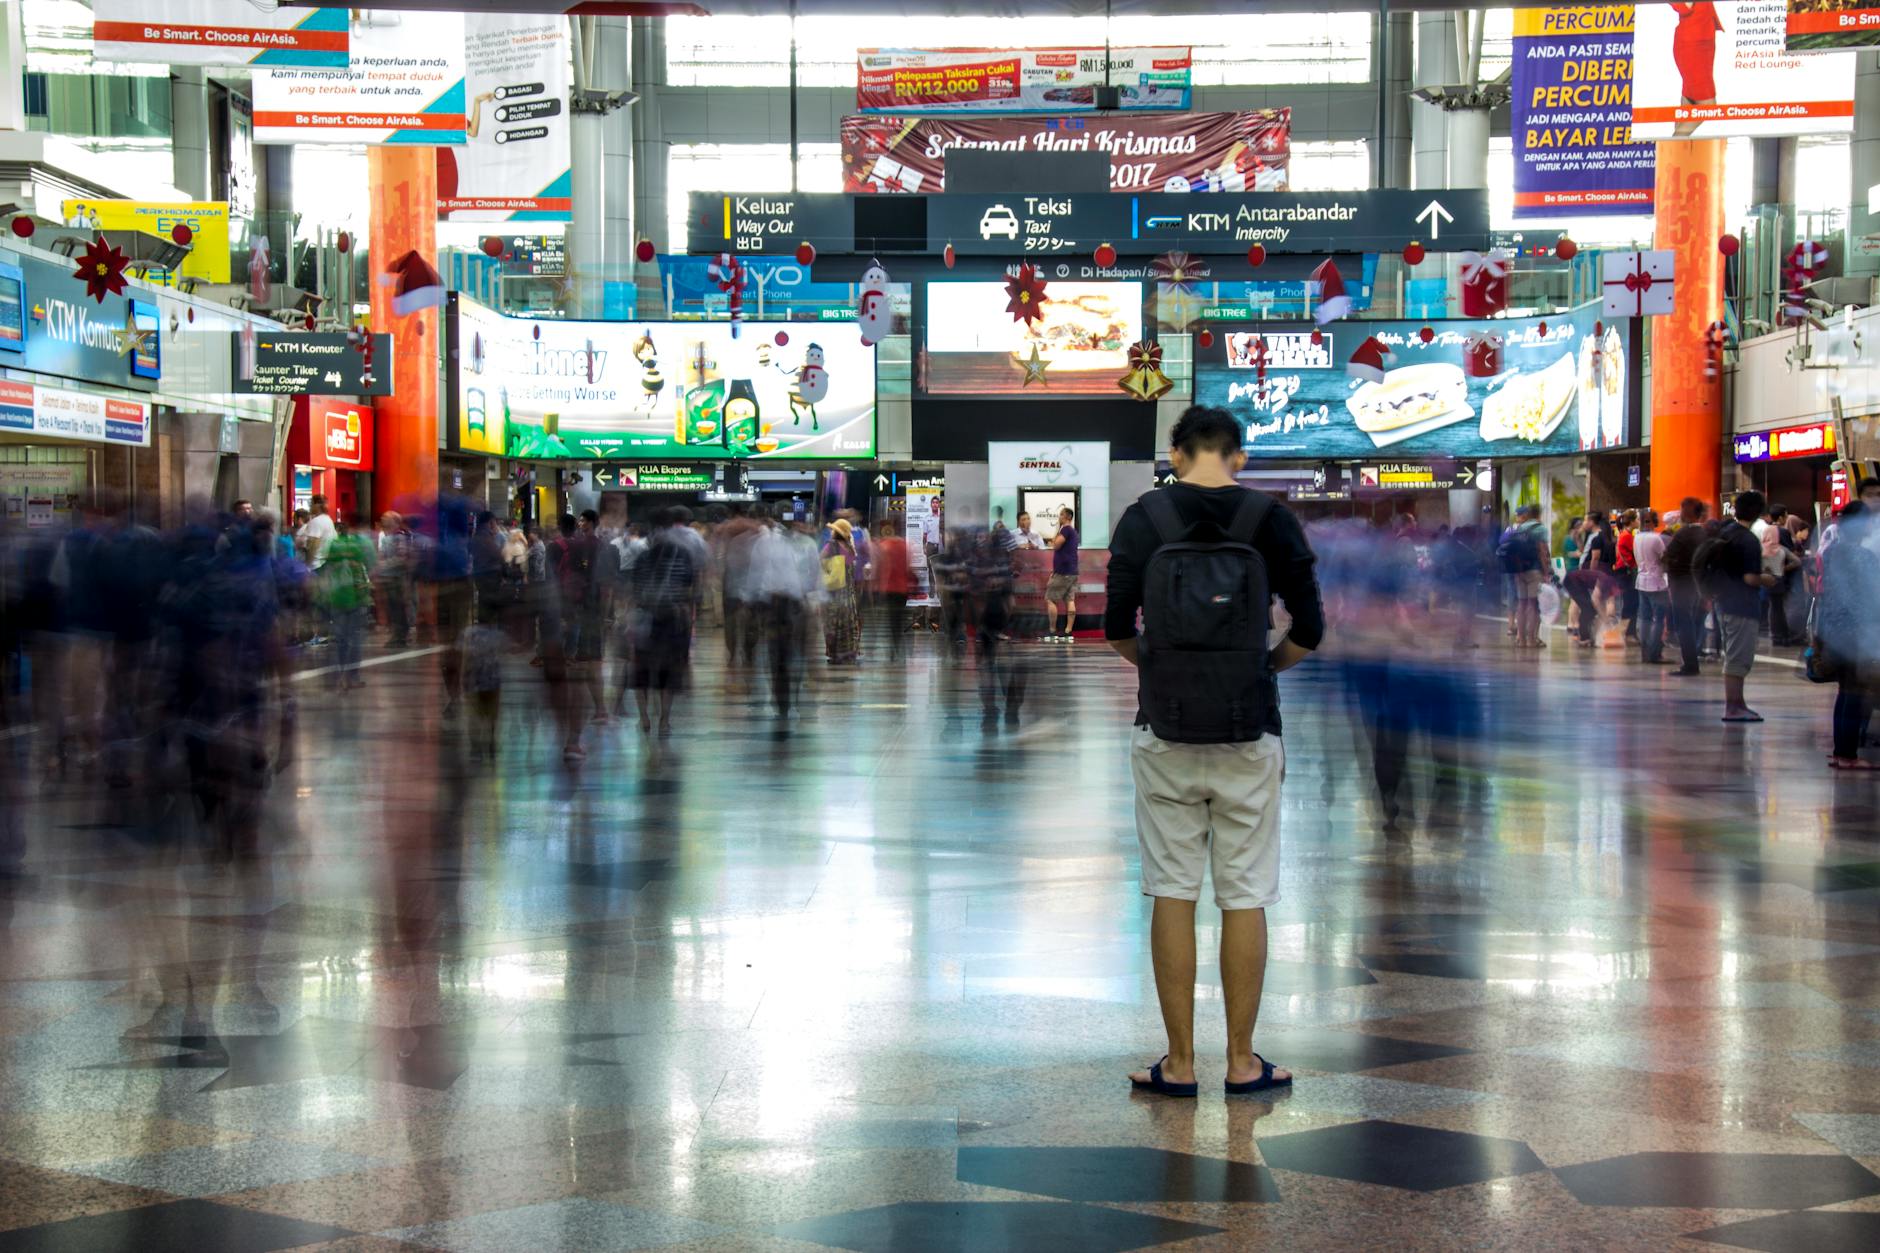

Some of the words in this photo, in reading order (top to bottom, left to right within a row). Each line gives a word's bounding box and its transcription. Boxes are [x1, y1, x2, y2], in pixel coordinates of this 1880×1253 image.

[1737, 5, 1756, 14] dan
[1736, 16, 1770, 25] faedah
[1839, 16, 1856, 26] Be
[144, 27, 161, 39] Be
[163, 28, 202, 42] Smart.
[205, 30, 250, 44] Choose
[252, 33, 299, 46] AirAsia.
[1736, 27, 1780, 37] menarik,
[1736, 38, 1780, 48] percuma
[1527, 46, 1566, 59] ANDA
[1568, 44, 1602, 57] PASTI
[1735, 50, 1774, 59] AirAsia
[363, 56, 418, 69] keperluan
[1735, 61, 1756, 70] Red
[1760, 60, 1804, 70] Lounge.
[271, 69, 298, 79] kami
[300, 70, 365, 82] mempunyai
[368, 72, 406, 82] tempat
[410, 72, 444, 81] duduk
[944, 68, 986, 79] Taksiran
[986, 64, 1015, 75] Cukai
[862, 74, 893, 84] Nikmati
[288, 86, 316, 95] yang
[319, 85, 357, 94] terbaik
[360, 86, 391, 96] untuk
[394, 86, 423, 96] anda.
[508, 86, 532, 95] BAGASI
[895, 78, 978, 97] RM12,000
[1532, 84, 1632, 108] PERCUM
[508, 104, 526, 114] PILIH
[526, 102, 552, 111] TEMPAT
[1675, 109, 1689, 119] Be
[1691, 108, 1724, 118] Smart.
[1727, 107, 1766, 117] Choose
[1768, 106, 1808, 116] AirAsia.
[296, 115, 309, 124] Be
[311, 116, 344, 124] Smart.
[346, 116, 384, 125] Choose
[386, 117, 424, 126] AirAsia.
[509, 112, 533, 120] DUDUK
[1526, 113, 1550, 125] JADI
[1551, 112, 1604, 124] MENGAPA
[1607, 112, 1632, 122] AND
[510, 129, 544, 139] HIDANGAN
[1525, 128, 1596, 148] BAYAR
[1033, 132, 1091, 152] Hari
[1094, 130, 1197, 156] Krismas
[1524, 152, 1560, 162] DENGAN
[1586, 151, 1610, 160] ANDA
[1612, 150, 1641, 159] HANYA
[1536, 162, 1561, 172] UNTUK
[1562, 162, 1580, 171] APA
[1581, 161, 1606, 170] YANG
[1607, 160, 1632, 170] ANDA
[1557, 194, 1584, 202] Smart.
[1585, 193, 1616, 202] Choose
[1618, 192, 1648, 200] AirAsia.
[448, 200, 474, 208] Smart.
[476, 200, 506, 208] Choose
[508, 200, 538, 208] AirAsia.
[736, 198, 794, 216] Keluar
[1024, 198, 1072, 216] Teksi
[135, 208, 222, 216] PERKHIDMATAN
[1188, 213, 1230, 232] KTM
[1236, 204, 1358, 222] Antarabandar
[736, 220, 765, 236] Way
[768, 219, 794, 234] Out
[1024, 220, 1051, 234] Taxi
[1236, 226, 1290, 243] Intercity
[736, 237, 763, 250] 出口
[1024, 238, 1076, 251] タクシー
[1080, 266, 1094, 278] Di
[1096, 266, 1141, 280] Hadapan
[763, 290, 792, 298] Phone
[823, 310, 839, 318] BIG
[1204, 308, 1220, 318] BIG
[1221, 308, 1247, 317] TREE
[46, 298, 77, 344] KTM
[79, 306, 122, 353] Komute
[274, 343, 300, 354] KTM
[302, 343, 344, 354] Komuter
[253, 364, 290, 375] Kaunter
[292, 364, 319, 376] Tiket
[252, 376, 274, 384] Ticket
[278, 376, 310, 386] Counter
[574, 386, 617, 401] Worse
[638, 465, 660, 474] KLIA
[661, 465, 692, 476] Ekspres
[1380, 464, 1400, 472] KLIA
[1402, 464, 1433, 474] Ekspres
[912, 480, 930, 488] KTM
